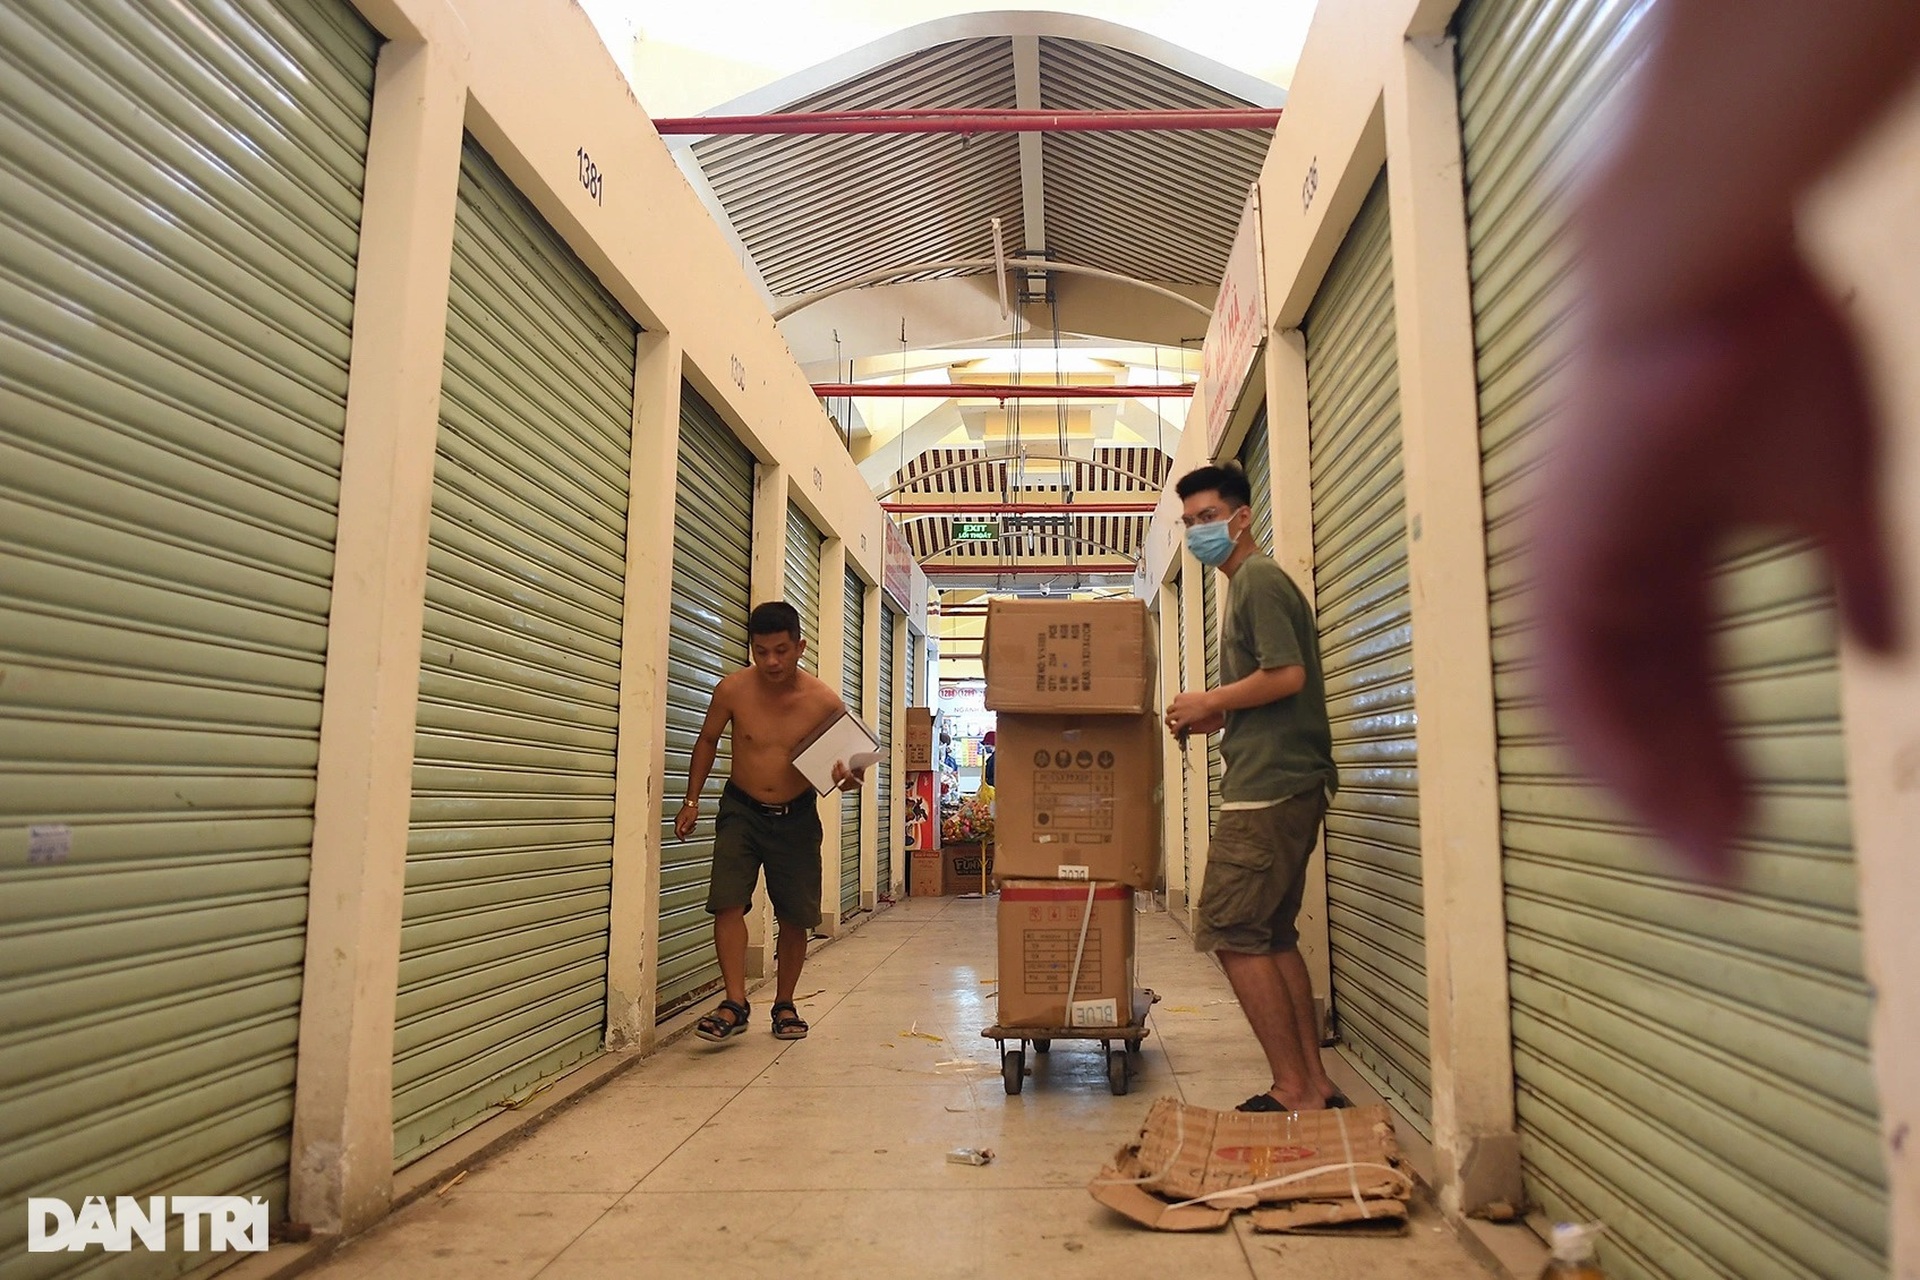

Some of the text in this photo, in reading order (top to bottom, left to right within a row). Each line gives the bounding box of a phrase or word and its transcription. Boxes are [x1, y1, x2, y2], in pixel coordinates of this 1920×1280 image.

[577, 146, 603, 207] 1381
[963, 524, 987, 532] EXIT
[1076, 1005, 1113, 1024] BLUE
